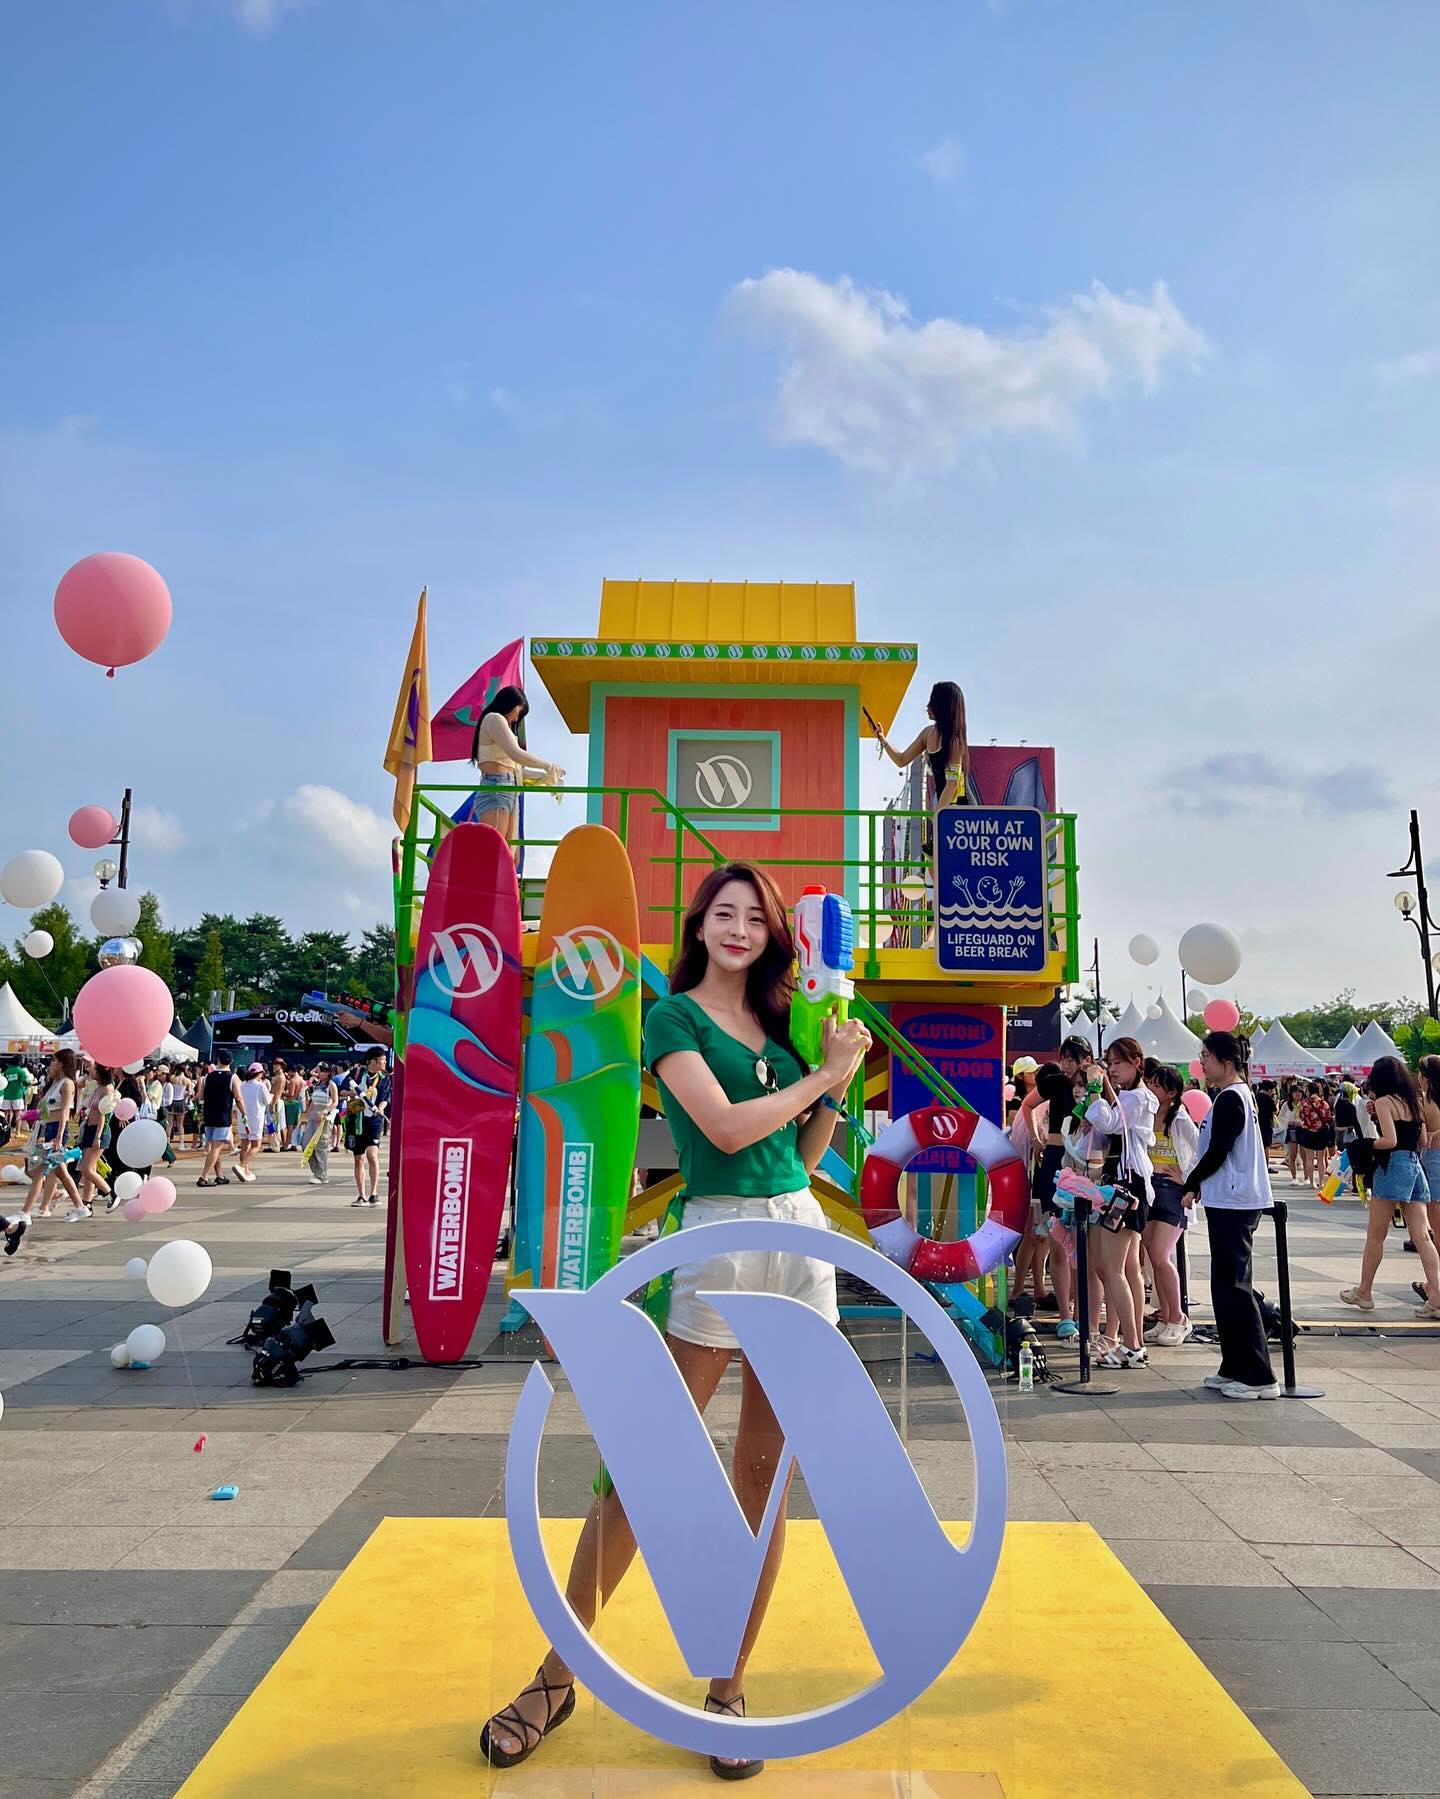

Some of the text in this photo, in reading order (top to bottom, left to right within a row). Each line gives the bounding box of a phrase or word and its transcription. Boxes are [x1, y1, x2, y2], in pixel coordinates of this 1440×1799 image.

[954, 820, 1025, 835] SWIM AT
[946, 836, 1033, 851] YOUR OWN
[971, 851, 1009, 867] RISK
[947, 933, 1036, 946] LIFEGUARD ON
[955, 946, 1029, 959] BEER BREAK
[908, 1023, 986, 1040] CAUTION!
[941, 1062, 993, 1078] FLOOR
[909, 1149, 960, 1169] 끄러짐
[437, 1146, 465, 1291] WATERBOMB
[561, 1151, 587, 1290] WATERBOMB
